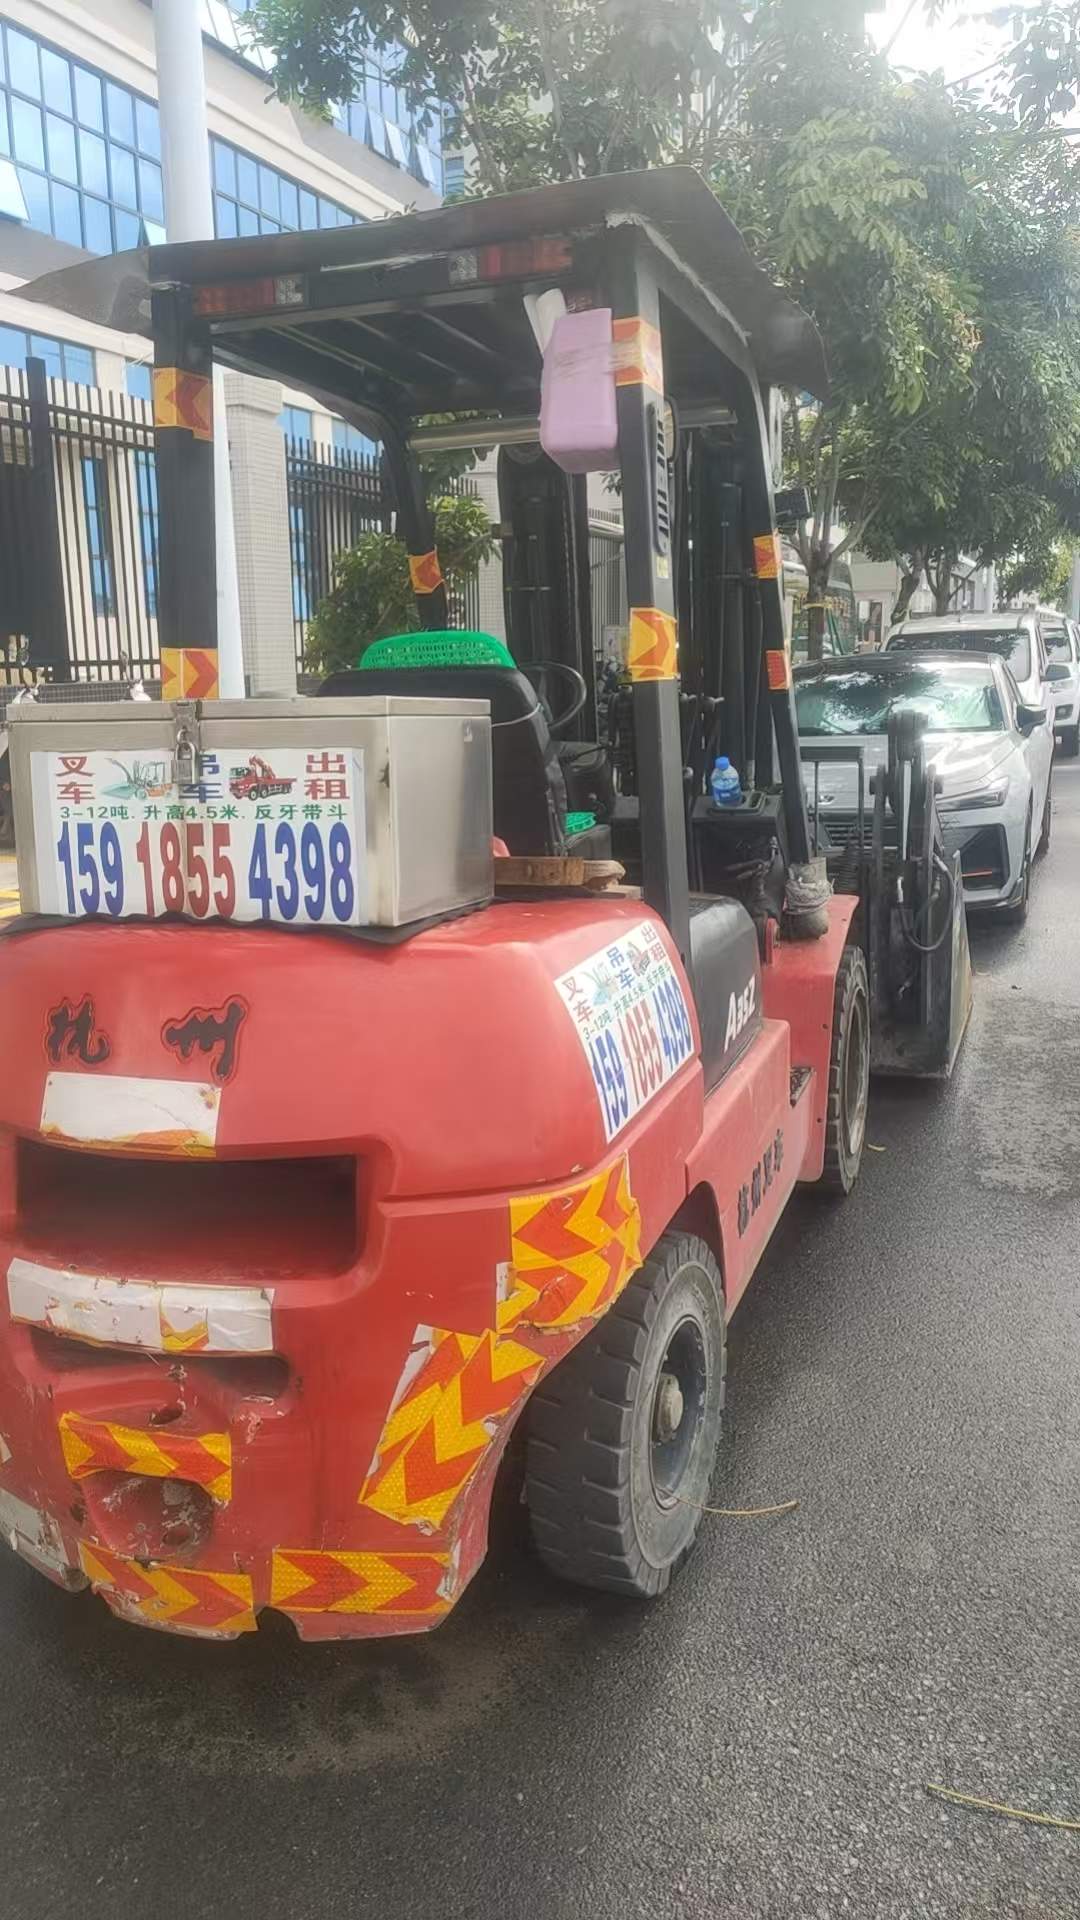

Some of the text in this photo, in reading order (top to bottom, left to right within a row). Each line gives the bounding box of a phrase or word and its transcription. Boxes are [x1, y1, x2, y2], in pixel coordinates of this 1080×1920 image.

[55, 756, 96, 804] 叉车
[304, 752, 350, 800] 出租
[58, 822, 354, 922] 159 1855 4398
[589, 975, 692, 1135] 159 1855 4398
